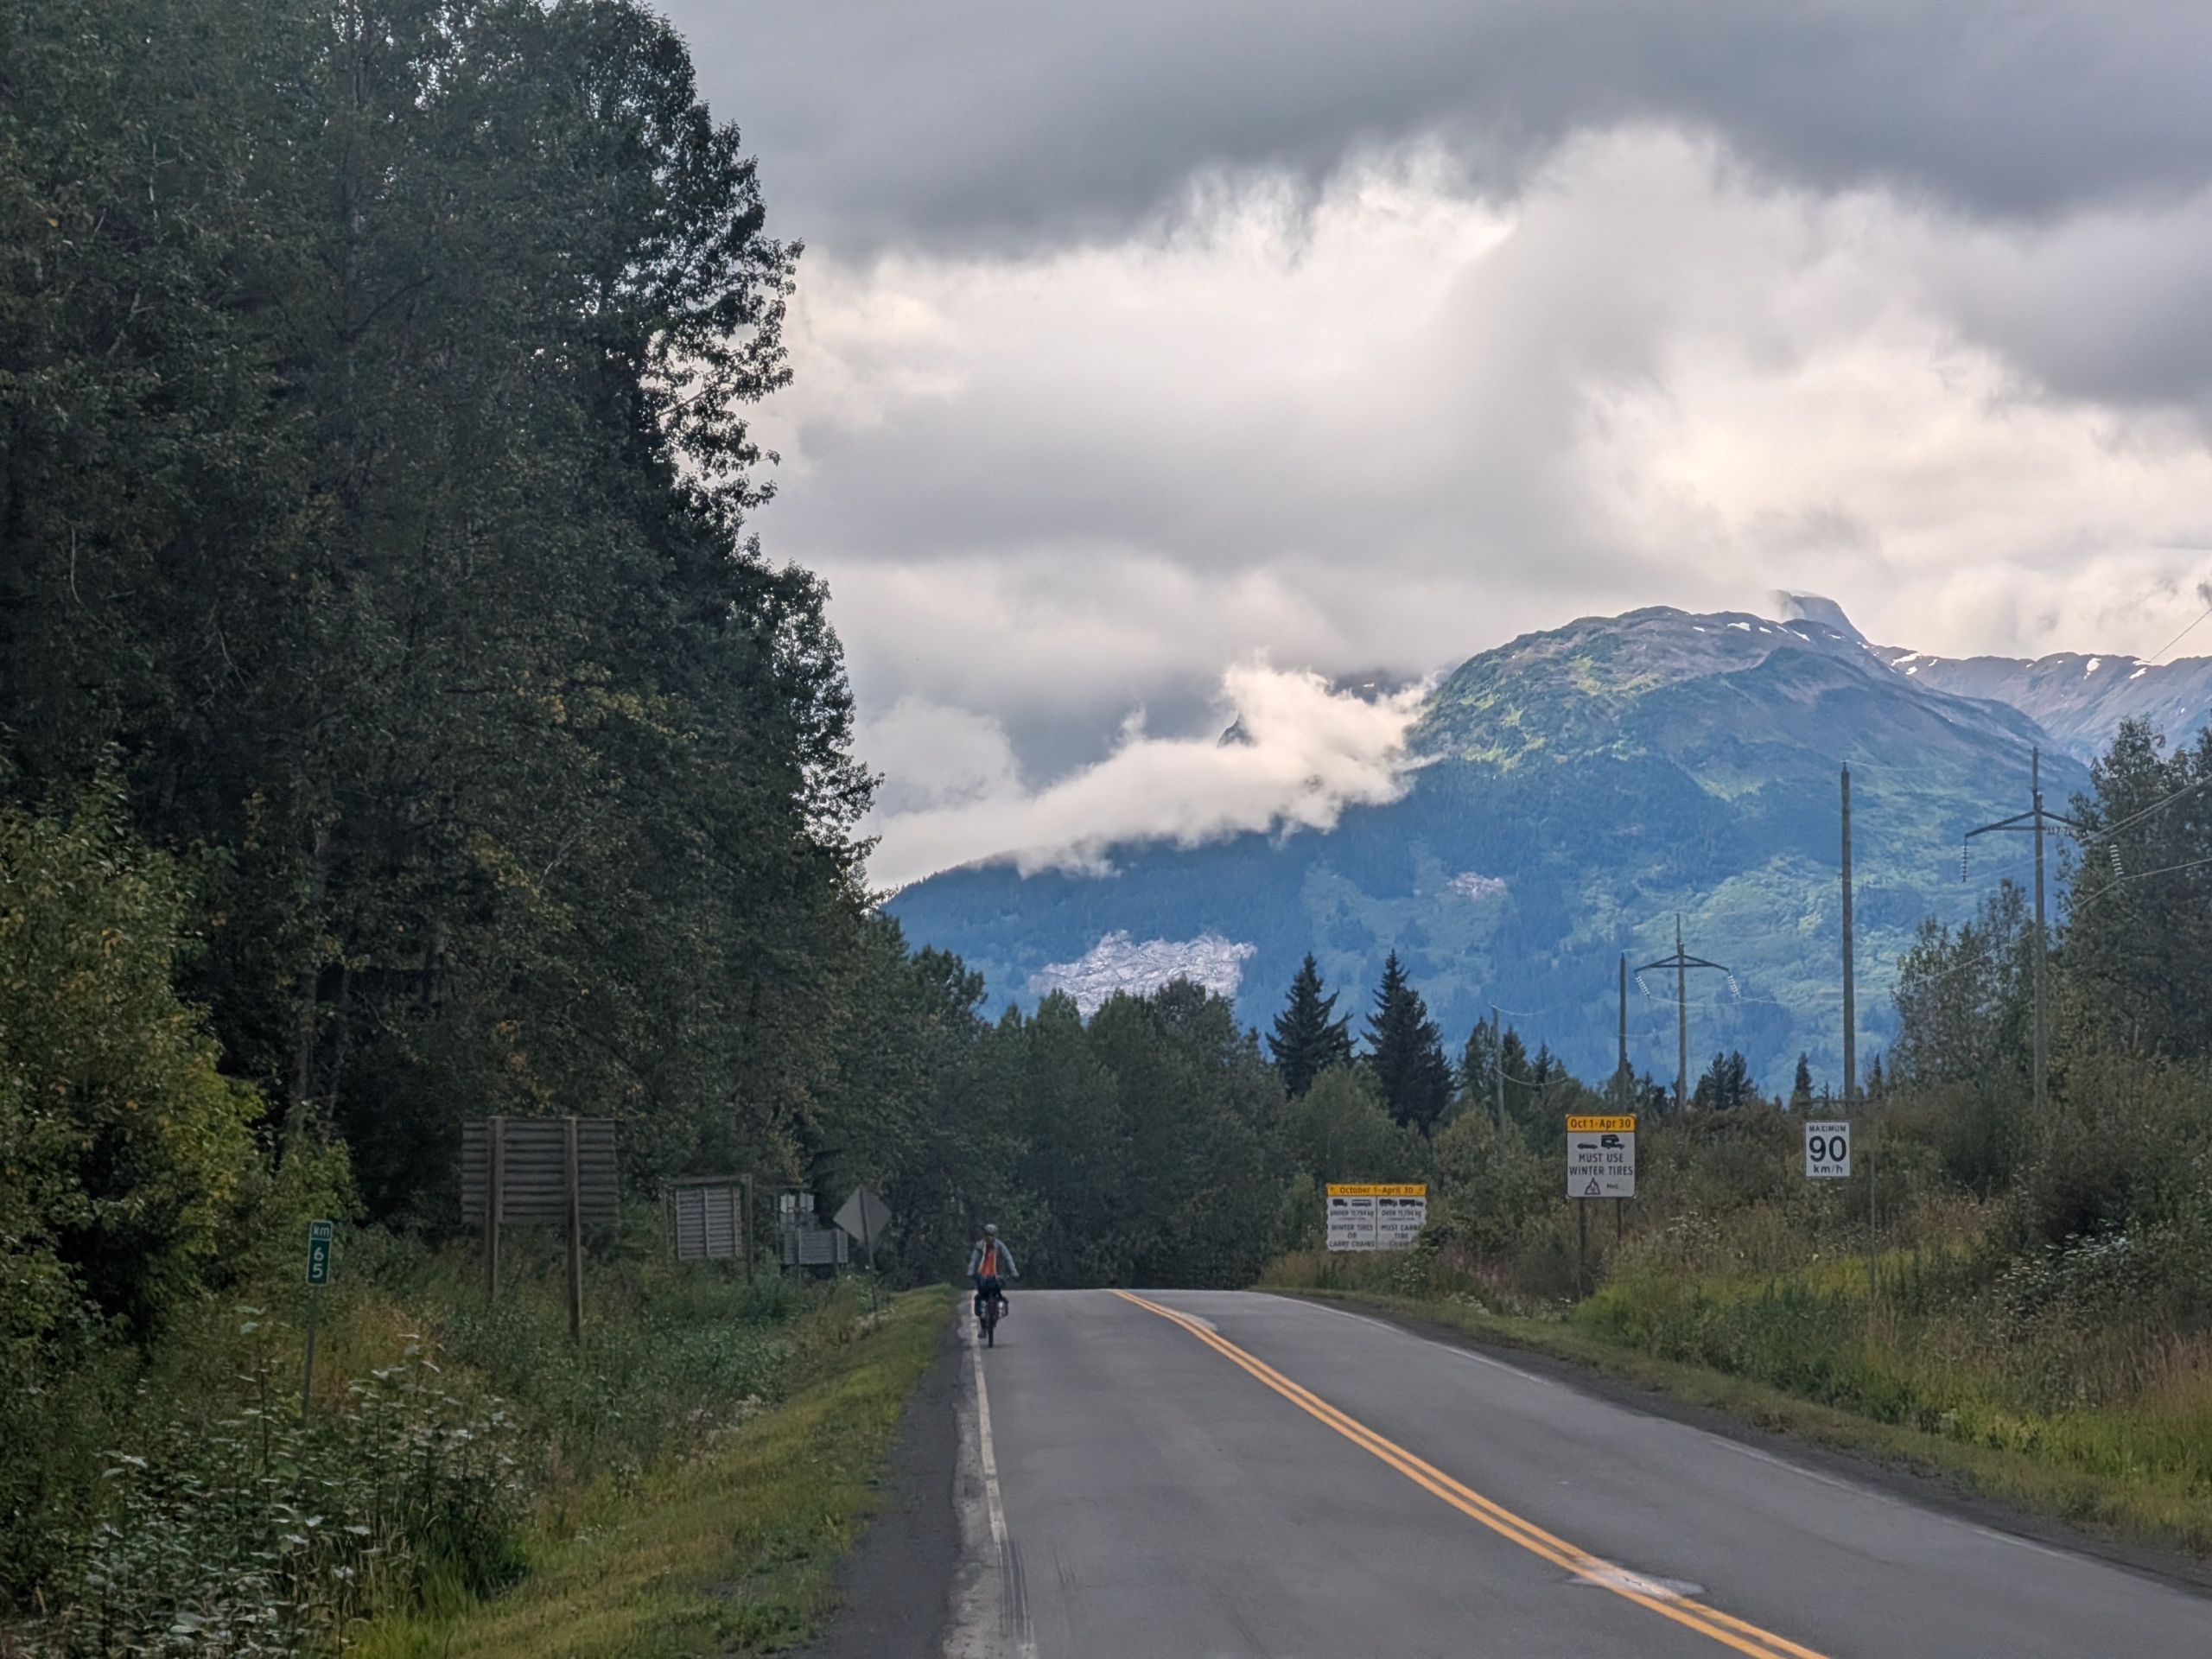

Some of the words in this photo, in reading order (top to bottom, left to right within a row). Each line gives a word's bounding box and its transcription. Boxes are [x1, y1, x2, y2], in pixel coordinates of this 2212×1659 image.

[1571, 1119, 1586, 1128] Oct
[1619, 1119, 1631, 1128] 30
[1808, 1135, 1847, 1162] 90
[1579, 1154, 1602, 1163] MUST
[1606, 1154, 1624, 1162] USE
[1569, 1166, 1605, 1175] WINTER
[1609, 1166, 1633, 1175] TIRES
[1814, 1164, 1843, 1173] km/h
[313, 1225, 330, 1237] km
